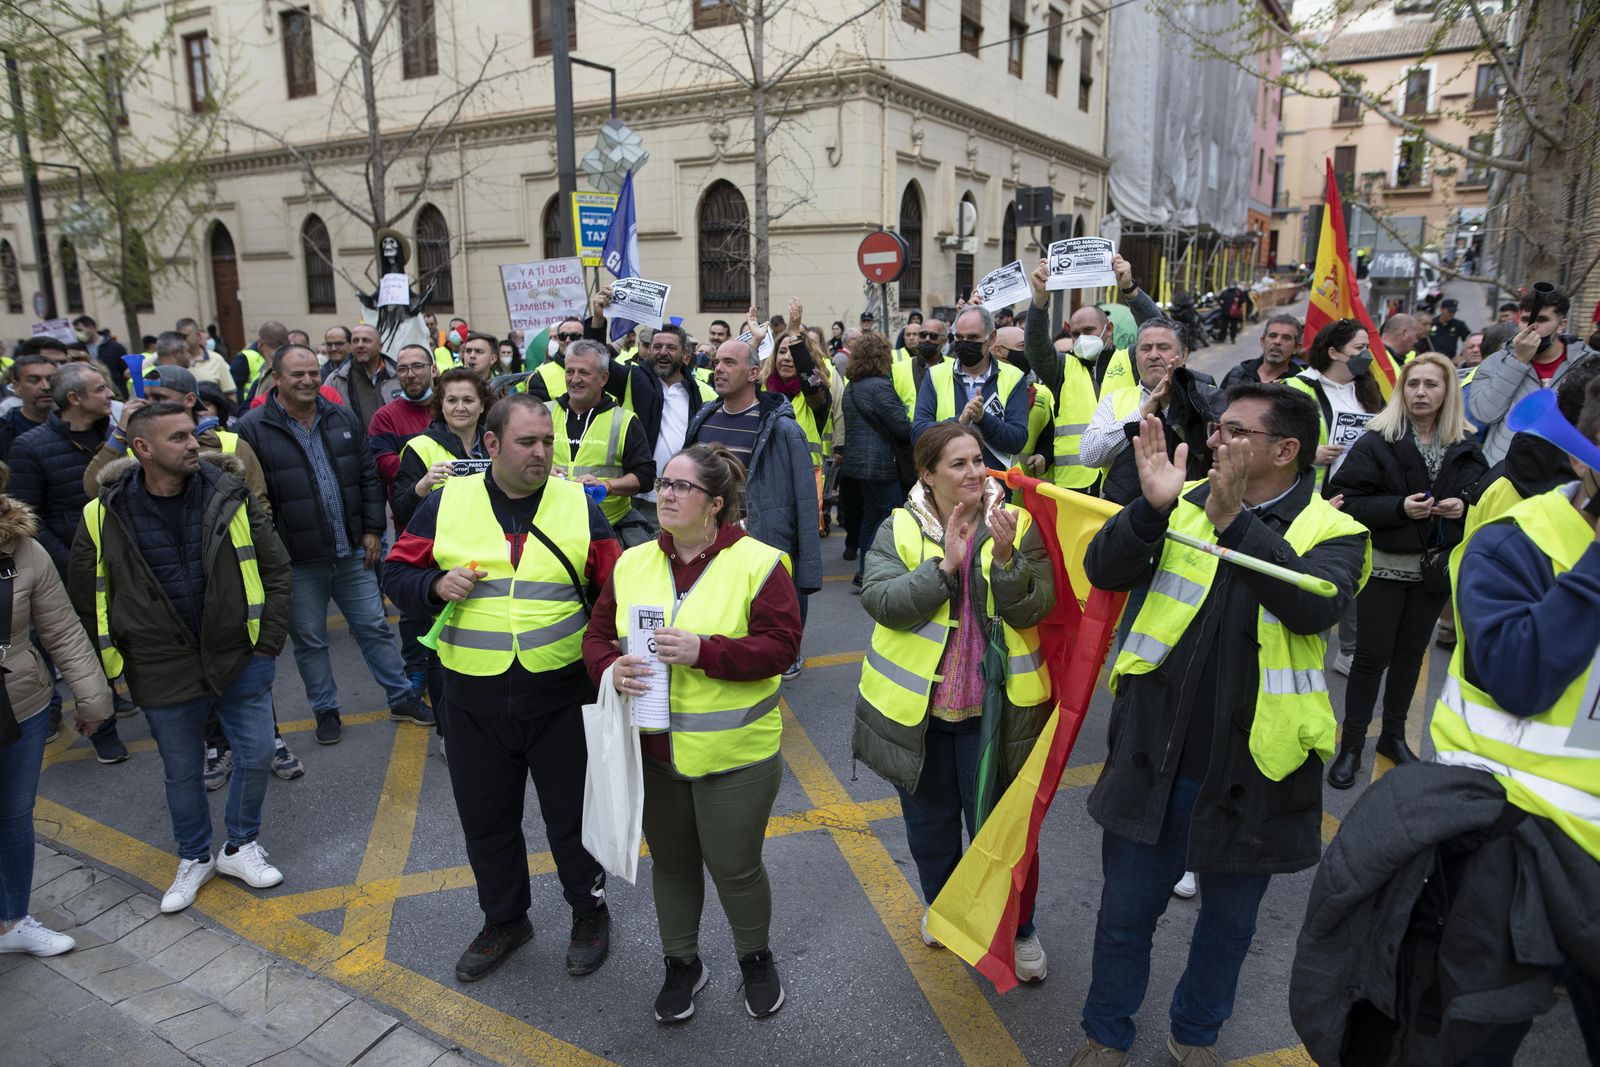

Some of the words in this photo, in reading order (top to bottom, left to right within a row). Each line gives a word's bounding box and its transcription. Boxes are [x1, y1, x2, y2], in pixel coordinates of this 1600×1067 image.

[586, 231, 606, 241] TAX
[520, 269, 526, 277] Y
[528, 268, 534, 276] A
[548, 264, 567, 274] QUE
[507, 280, 534, 291] ESTÁS
[537, 276, 584, 288] MIRANDO,
[514, 301, 555, 312] TAMBIÉN
[563, 299, 574, 308] TE
[513, 317, 541, 328] ESTÁN
